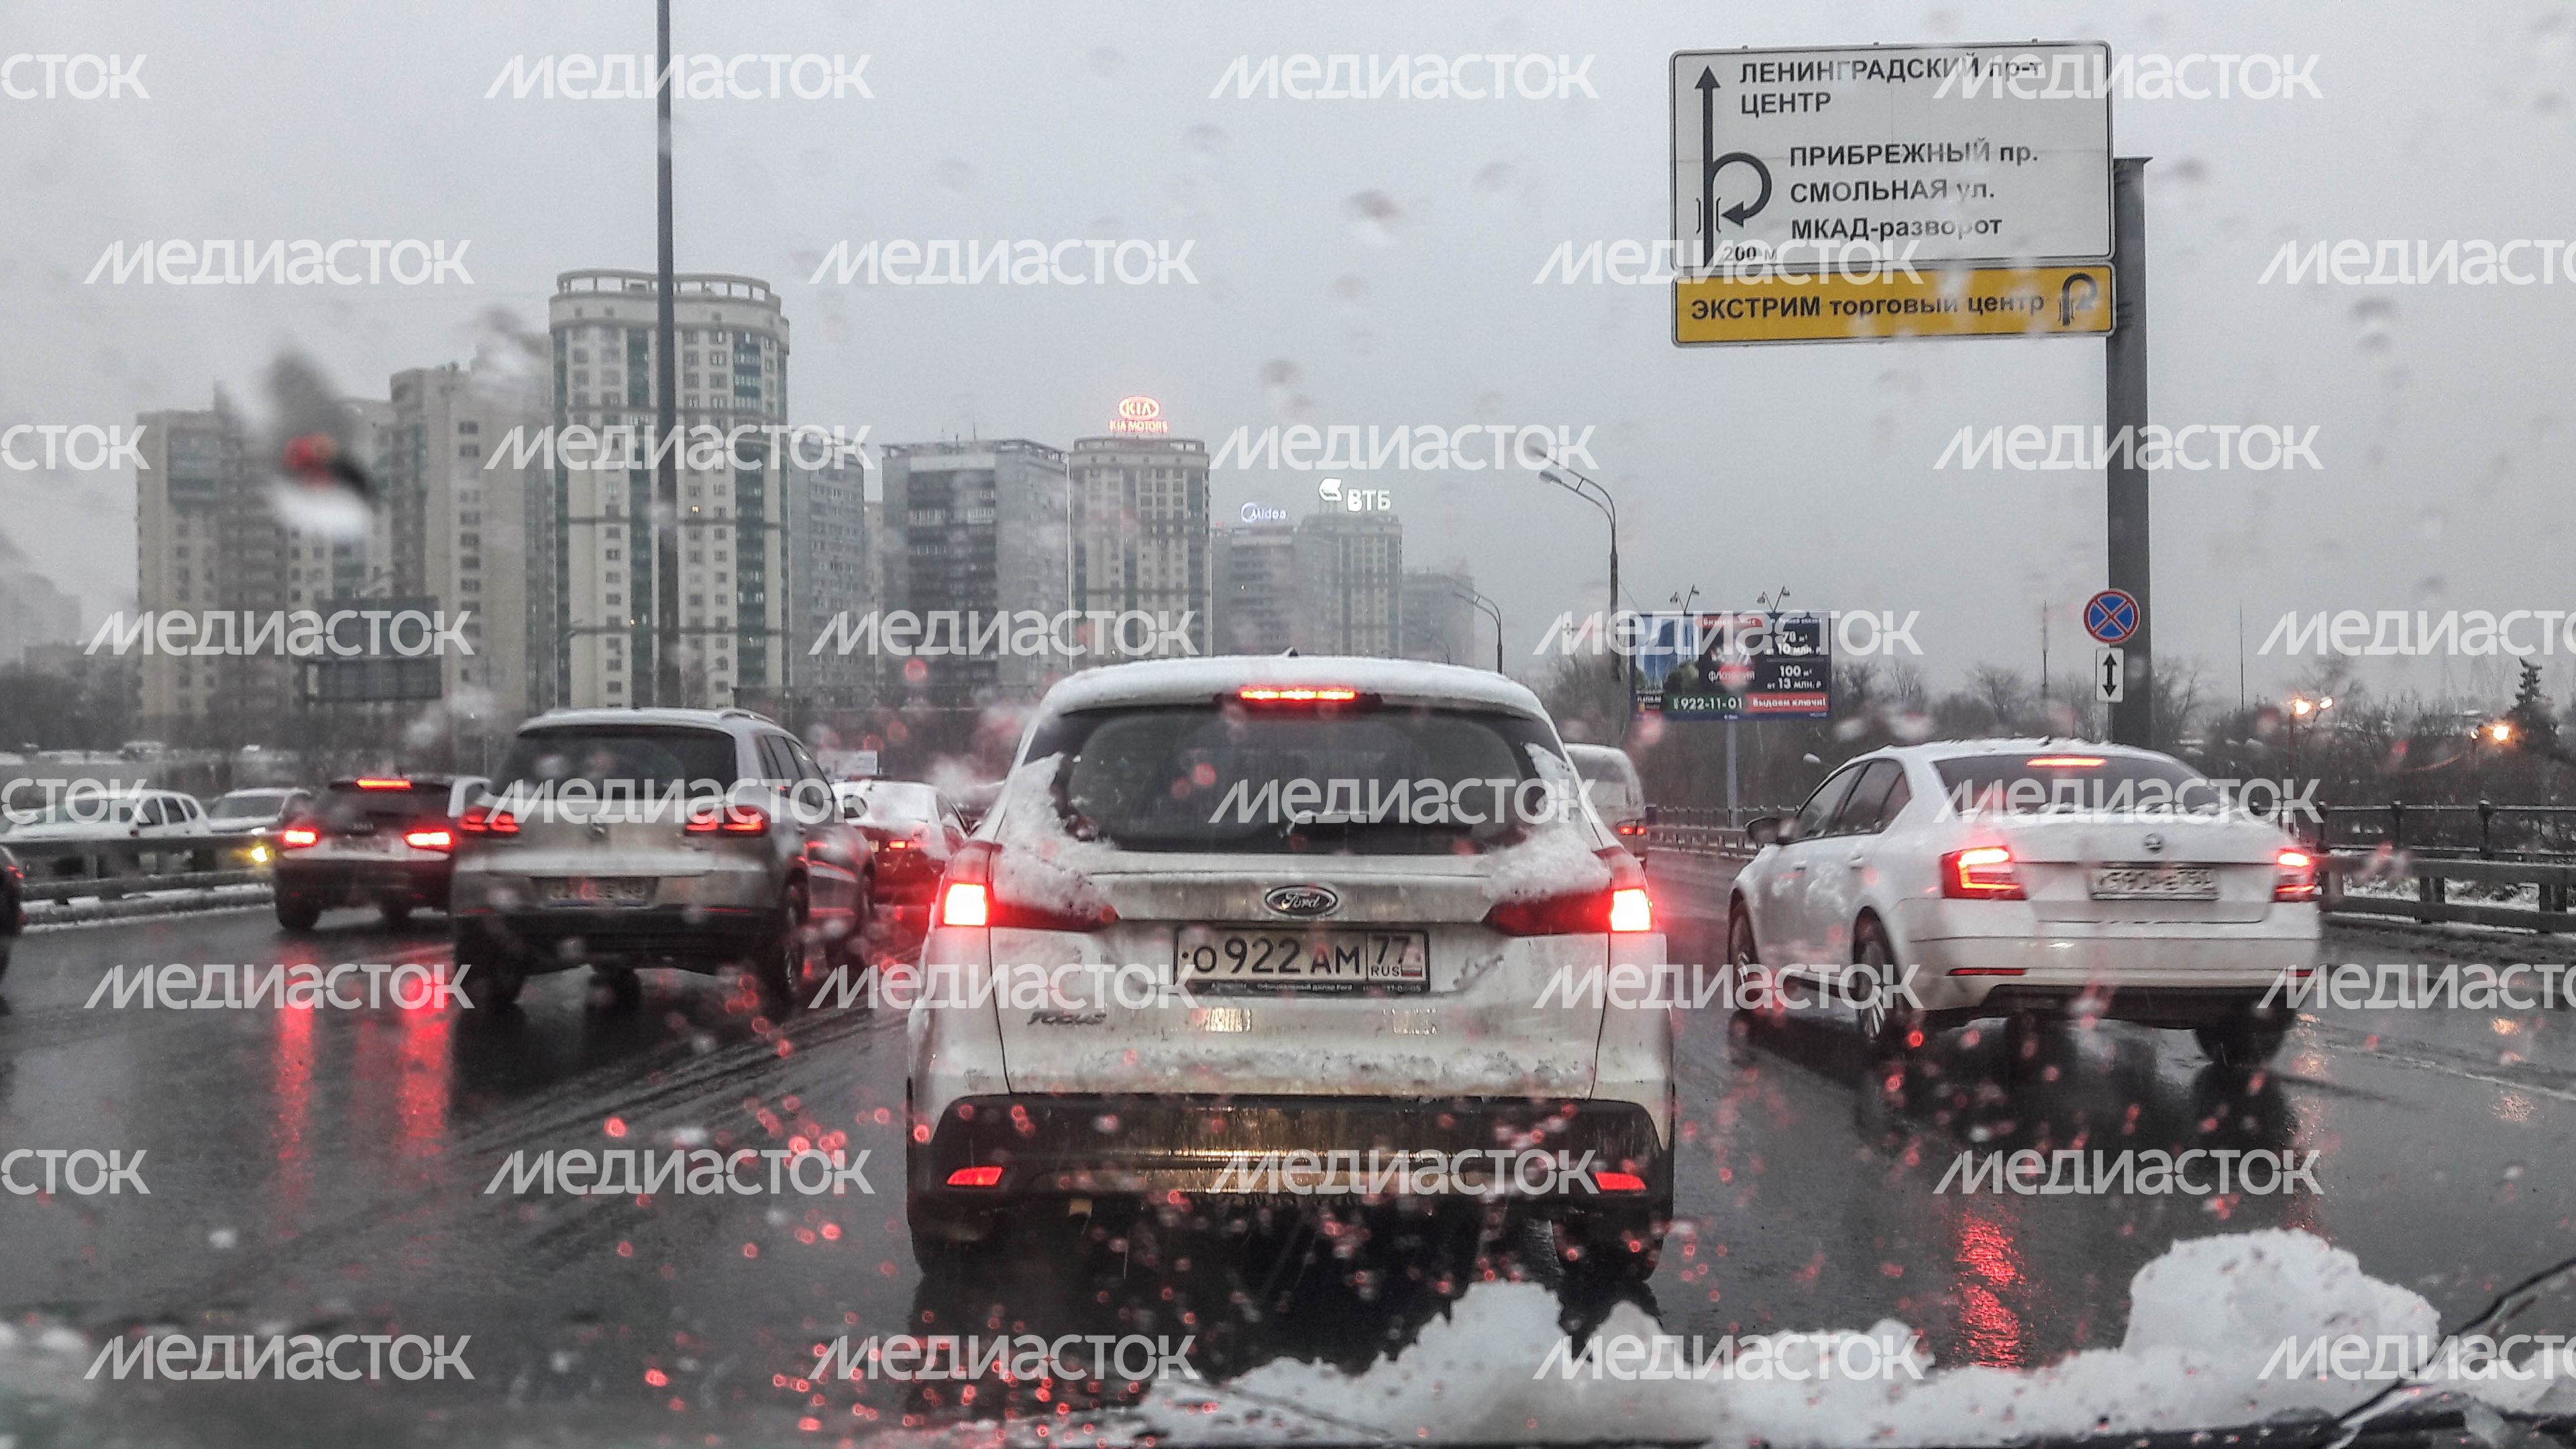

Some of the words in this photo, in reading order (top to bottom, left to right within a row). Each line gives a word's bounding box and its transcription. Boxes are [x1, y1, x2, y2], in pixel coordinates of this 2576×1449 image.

[1739, 52, 1979, 83] ЛЕНИНГРАДСКИЙ
[1741, 92, 1832, 118] ЦЕНТР
[1790, 138, 1990, 167] ПРИБРЕЖНЫЙ
[2000, 146, 2039, 166] пр.
[1790, 178, 1947, 203] СМОЛЬНАЯ
[1956, 183, 1995, 202] ул.
[1723, 246, 1757, 261] 200
[1691, 296, 1820, 319] ЭКСТРИМ
[1829, 297, 1958, 318] торговый
[1968, 294, 2045, 315] центр
[1124, 400, 1155, 417] KIA
[1109, 419, 1127, 432] KIA
[1128, 419, 1169, 433] MOTORS
[1347, 488, 1391, 512] ВТБ
[1779, 665, 1802, 678] 100
[1778, 678, 1791, 690] 13
[1281, 893, 1321, 909] Ford
[1371, 965, 1399, 977] RUS
